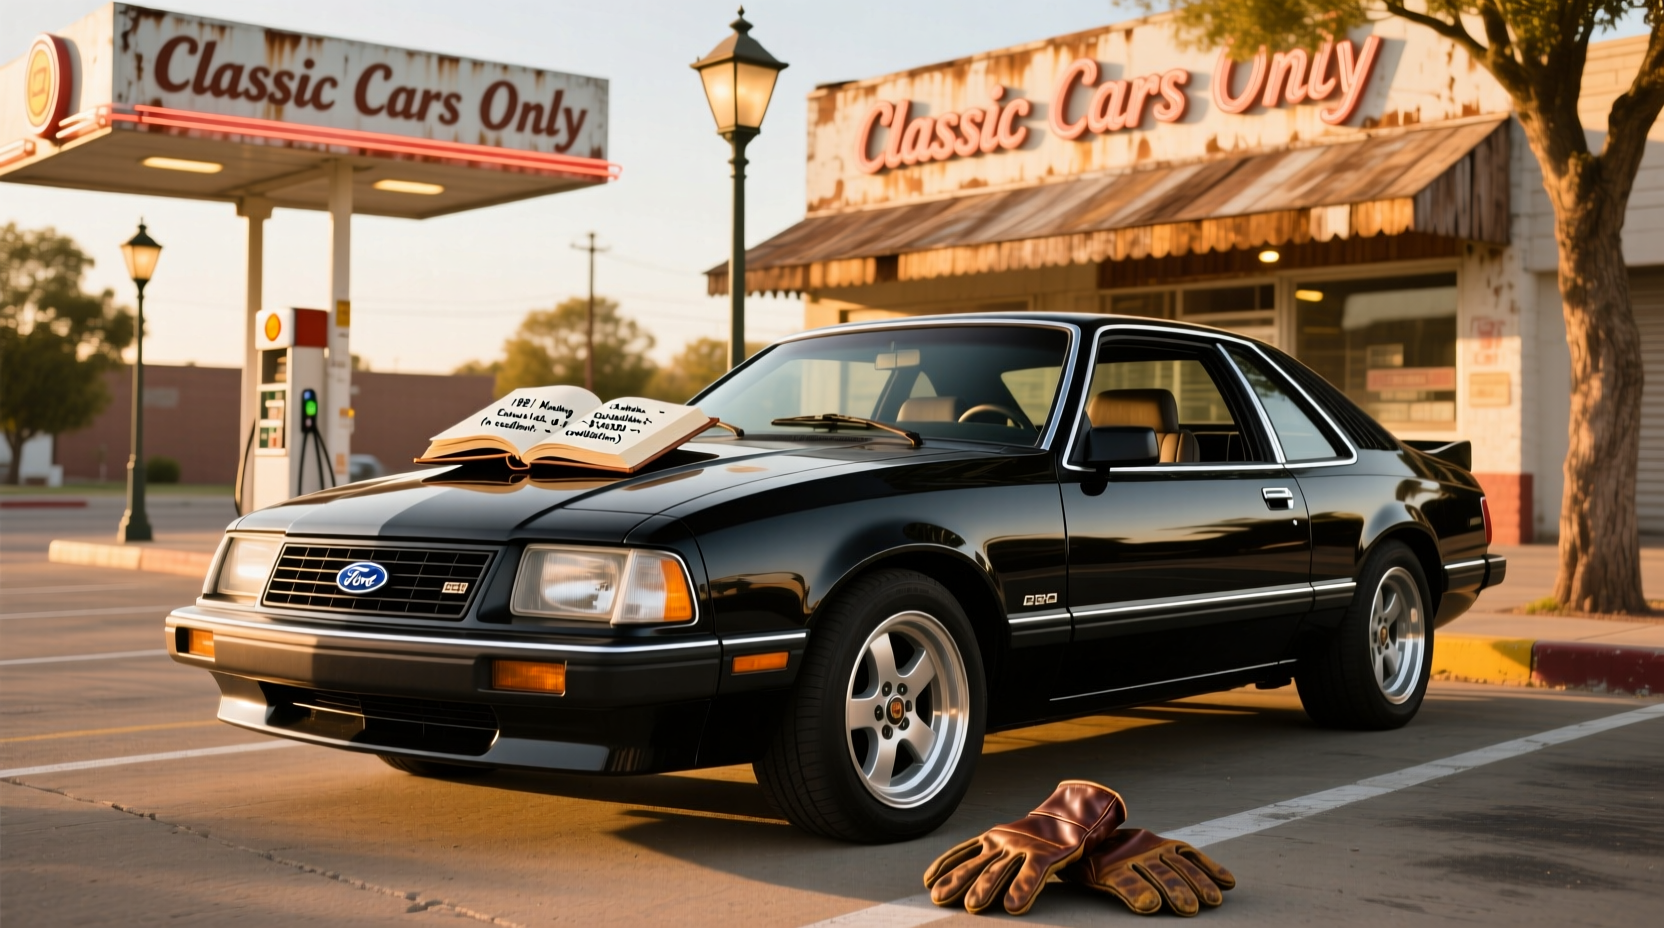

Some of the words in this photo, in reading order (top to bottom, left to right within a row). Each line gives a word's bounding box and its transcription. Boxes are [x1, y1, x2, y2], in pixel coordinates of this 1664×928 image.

[153, 34, 338, 111] Classic
[353, 63, 463, 126] Cars
[479, 80, 588, 152] Only
[857, 86, 1030, 174] Classic
[1049, 58, 1189, 140] Cars
[343, 566, 377, 587] Ford
